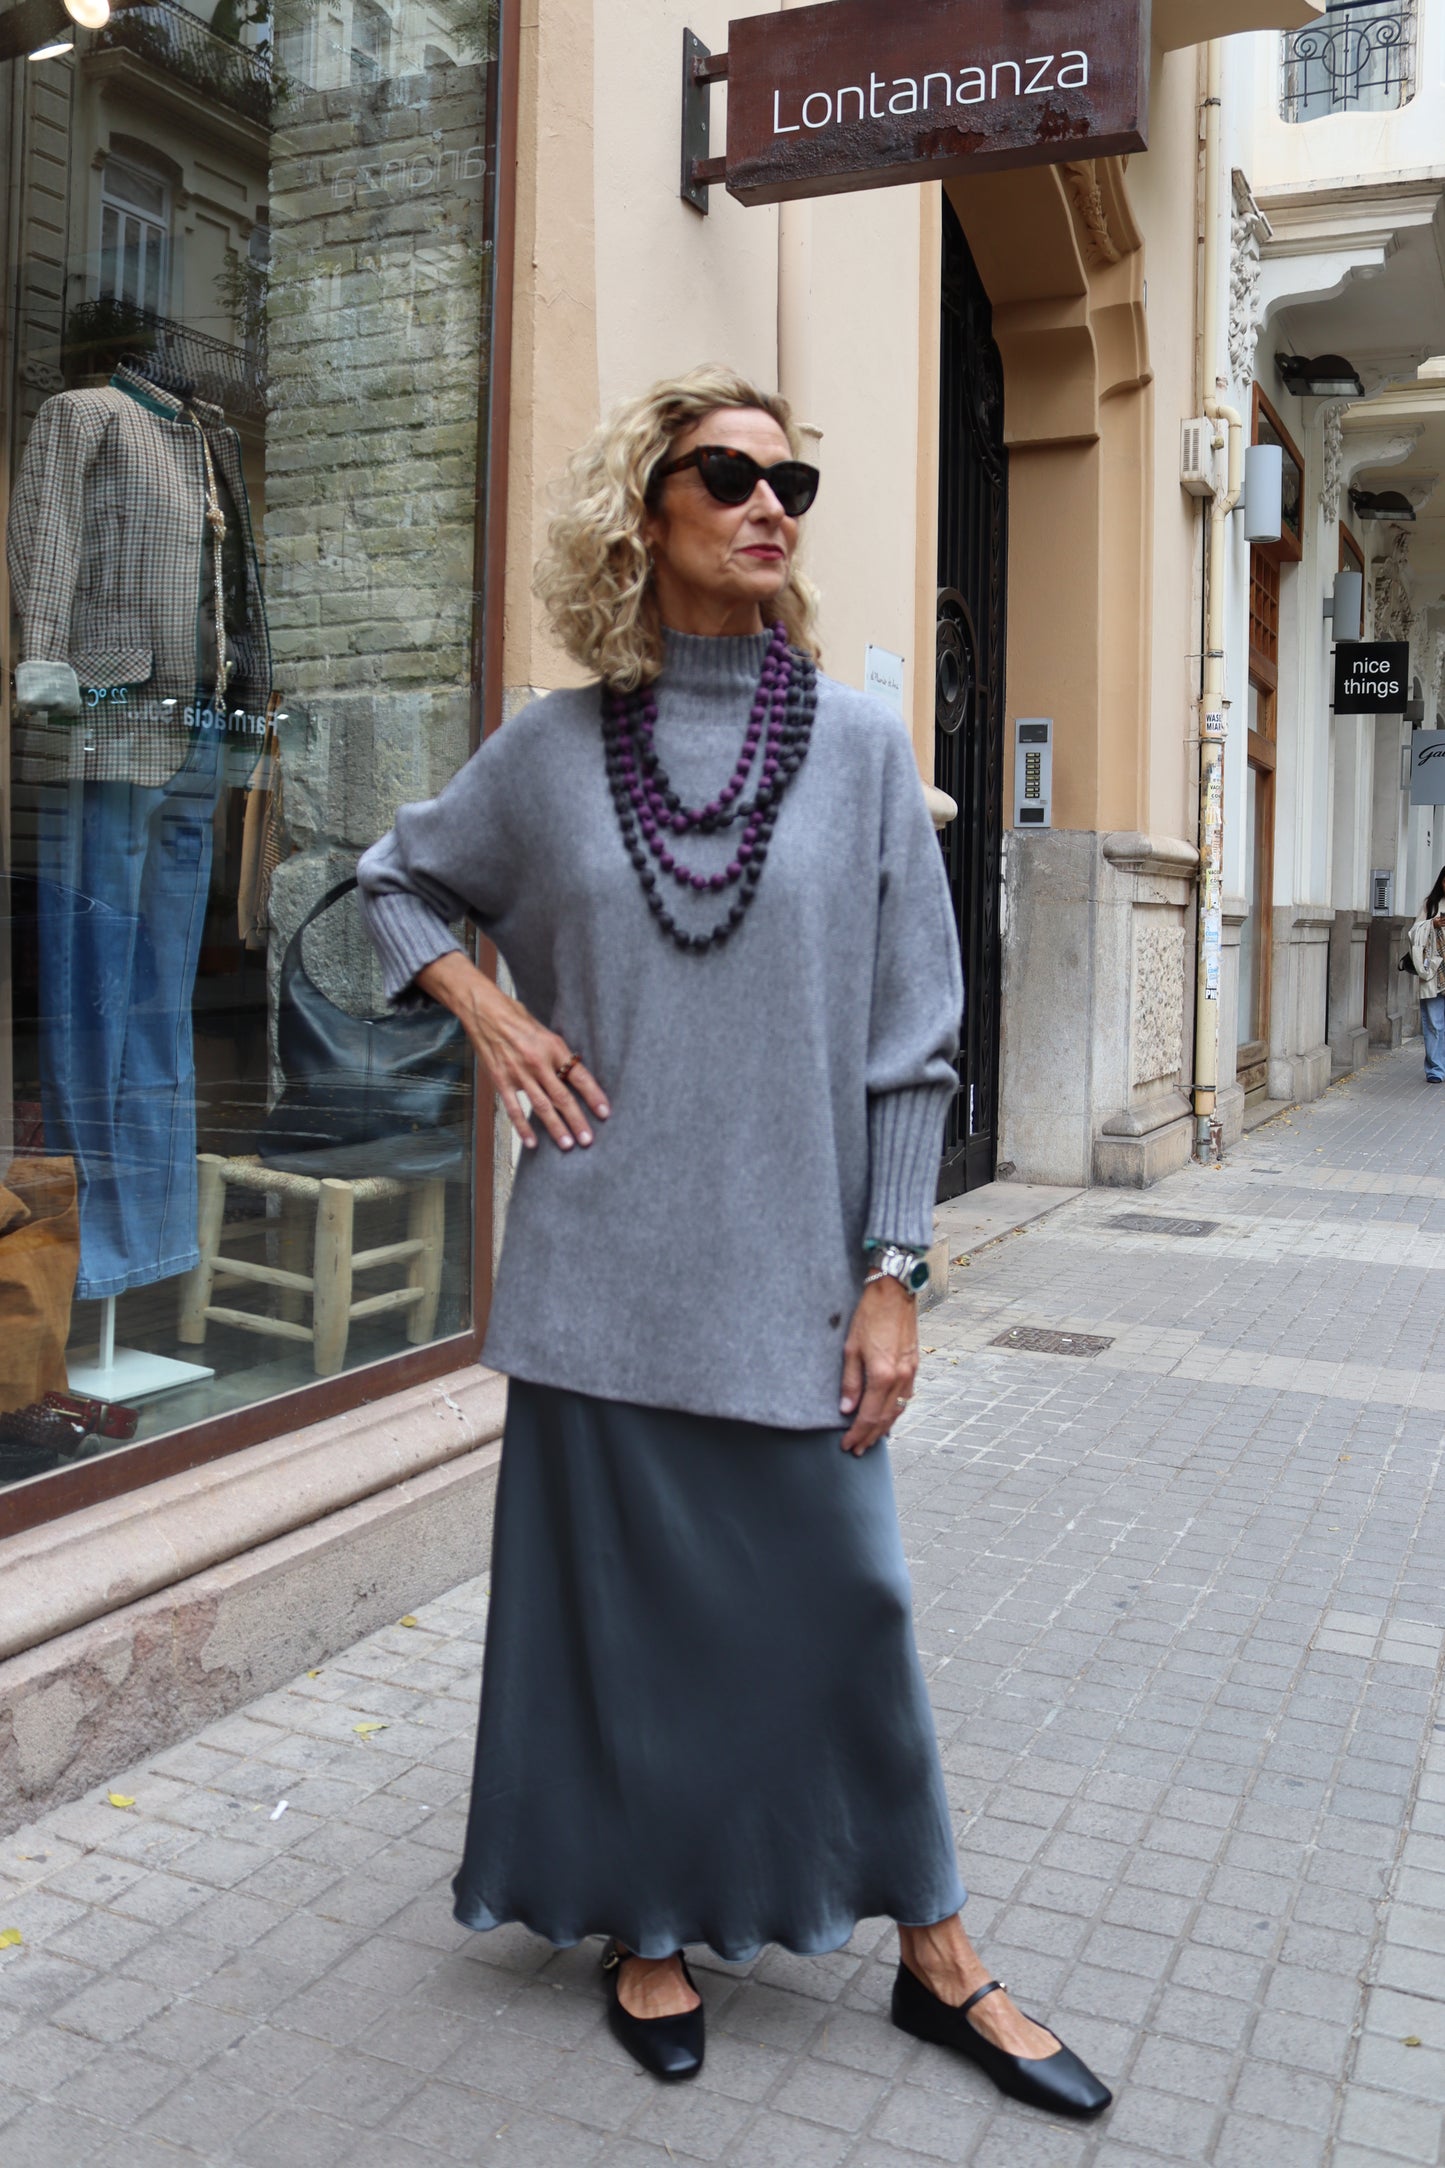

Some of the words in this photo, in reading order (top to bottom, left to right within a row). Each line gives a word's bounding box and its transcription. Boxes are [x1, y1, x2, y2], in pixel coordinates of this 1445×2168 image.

[773, 50, 1089, 134] Lontananza
[1353, 657, 1390, 674] nice
[1343, 679, 1399, 698] things
